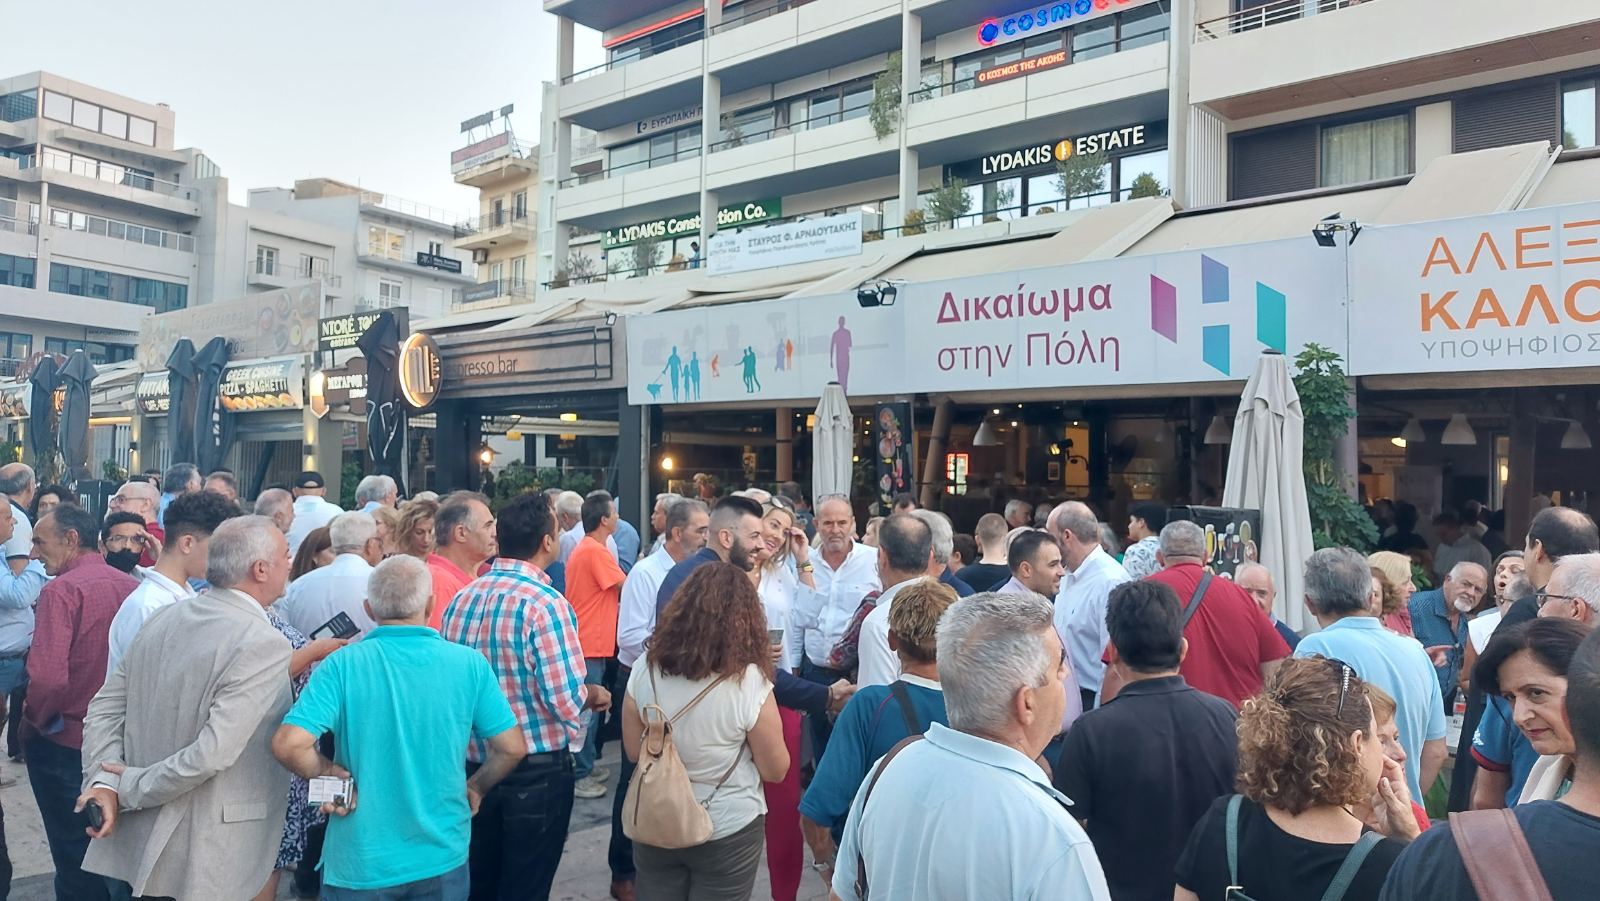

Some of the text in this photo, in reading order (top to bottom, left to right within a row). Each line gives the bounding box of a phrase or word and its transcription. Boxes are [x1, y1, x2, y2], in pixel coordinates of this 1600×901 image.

[987, 64, 1018, 80] ΚΟΣΜΟΣ
[1020, 59, 1035, 71] ΤΗΣ
[1036, 51, 1065, 67] ΑΚΟΗΣ
[982, 125, 1145, 175] LYDAKIS ESTATE
[619, 203, 767, 243] LYDAKIS Consttion Co.
[748, 234, 782, 248] ΣΤΑΥΡΟΣ
[783, 233, 793, 241] Φ.
[795, 221, 857, 240] ΑΡΝΑΟΥΤΑΚΗΣ
[1421, 219, 1600, 278] ΑΛΕΞ
[936, 278, 1112, 324] Δικαίωμα
[937, 333, 1120, 377] στην Πόλη
[1421, 333, 1600, 360] ΥΠΟΨΗΦΙΟΣ
[226, 368, 252, 382] GREEK
[498, 354, 519, 374] bar
[220, 377, 288, 396] PIZZA SPAGHETTI
